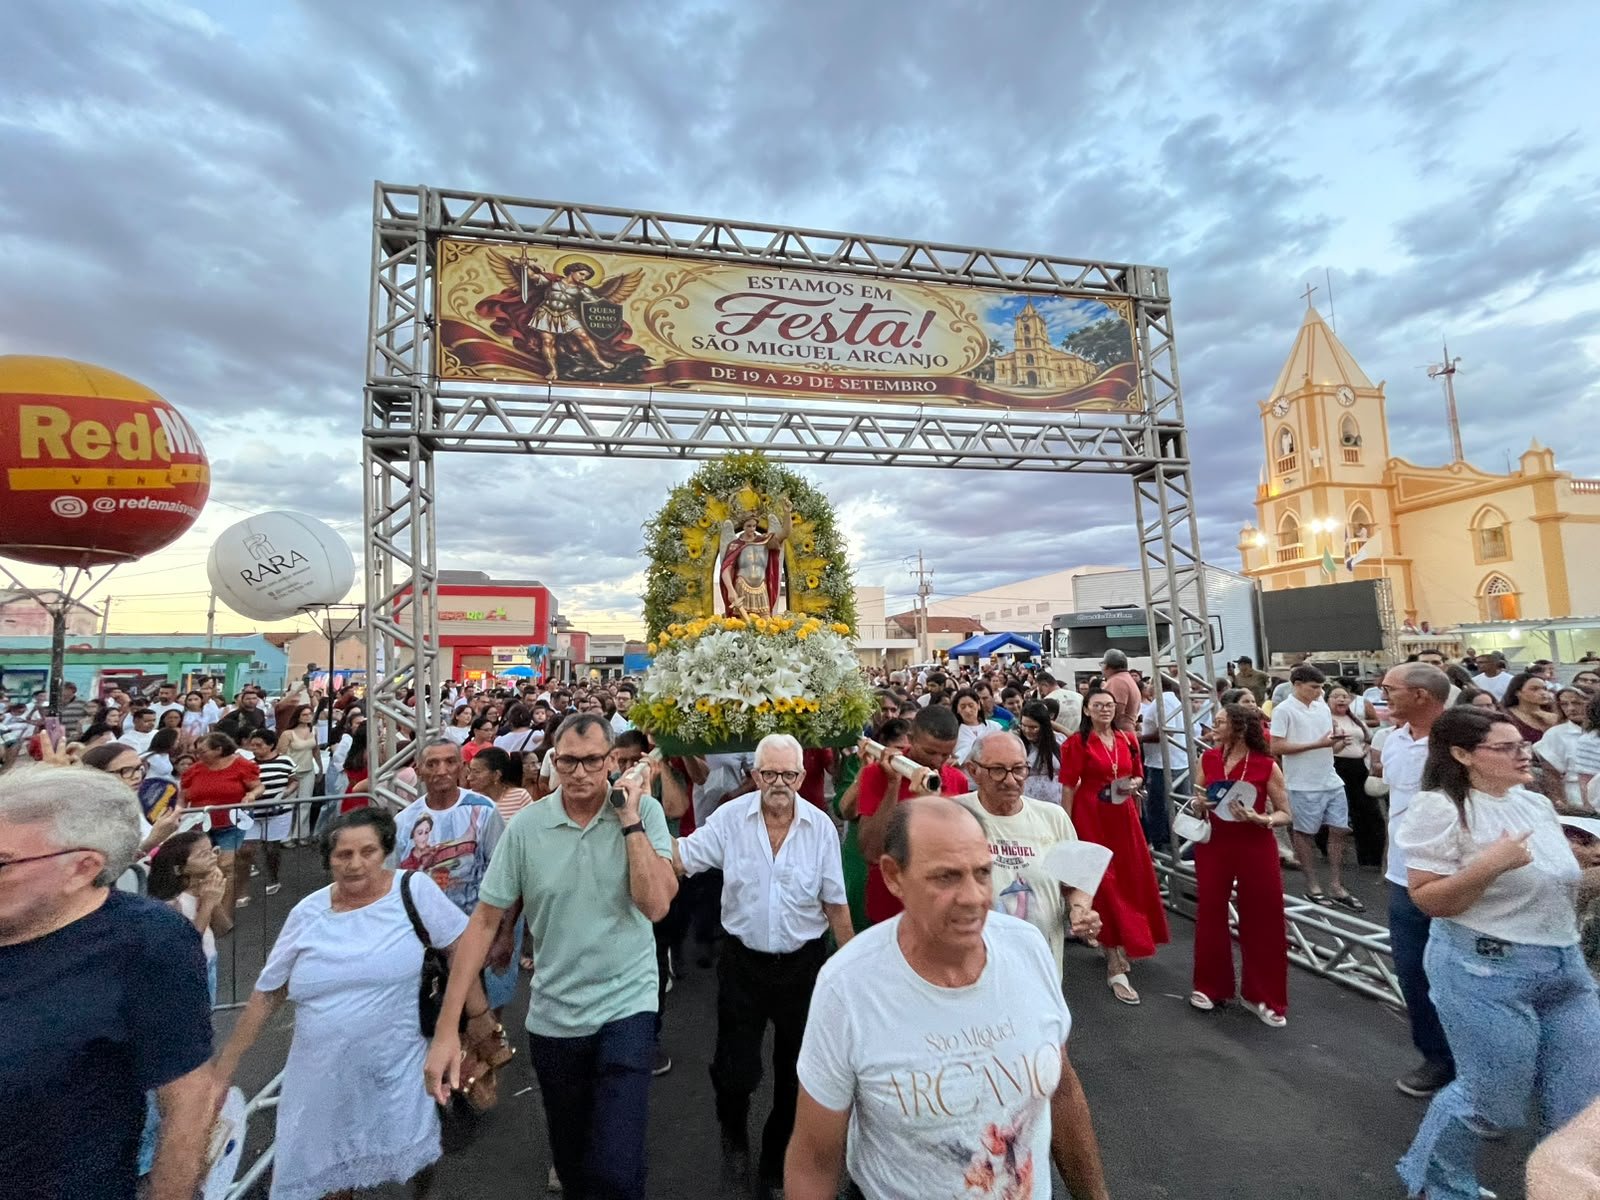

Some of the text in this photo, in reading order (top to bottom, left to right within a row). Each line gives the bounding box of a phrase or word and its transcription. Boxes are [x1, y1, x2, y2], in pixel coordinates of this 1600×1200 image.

[747, 276, 892, 301] ESTAMOS EM
[589, 306, 616, 314] QUEM
[589, 314, 617, 322] COMO
[714, 292, 937, 349] Festa!
[691, 334, 949, 369] SÃO MIGUEL ARCANJO
[710, 367, 937, 392] DE 19 A 29 DE SETEMBRO
[240, 550, 309, 586] RARA
[1001, 845, 1035, 857] MIGUEL
